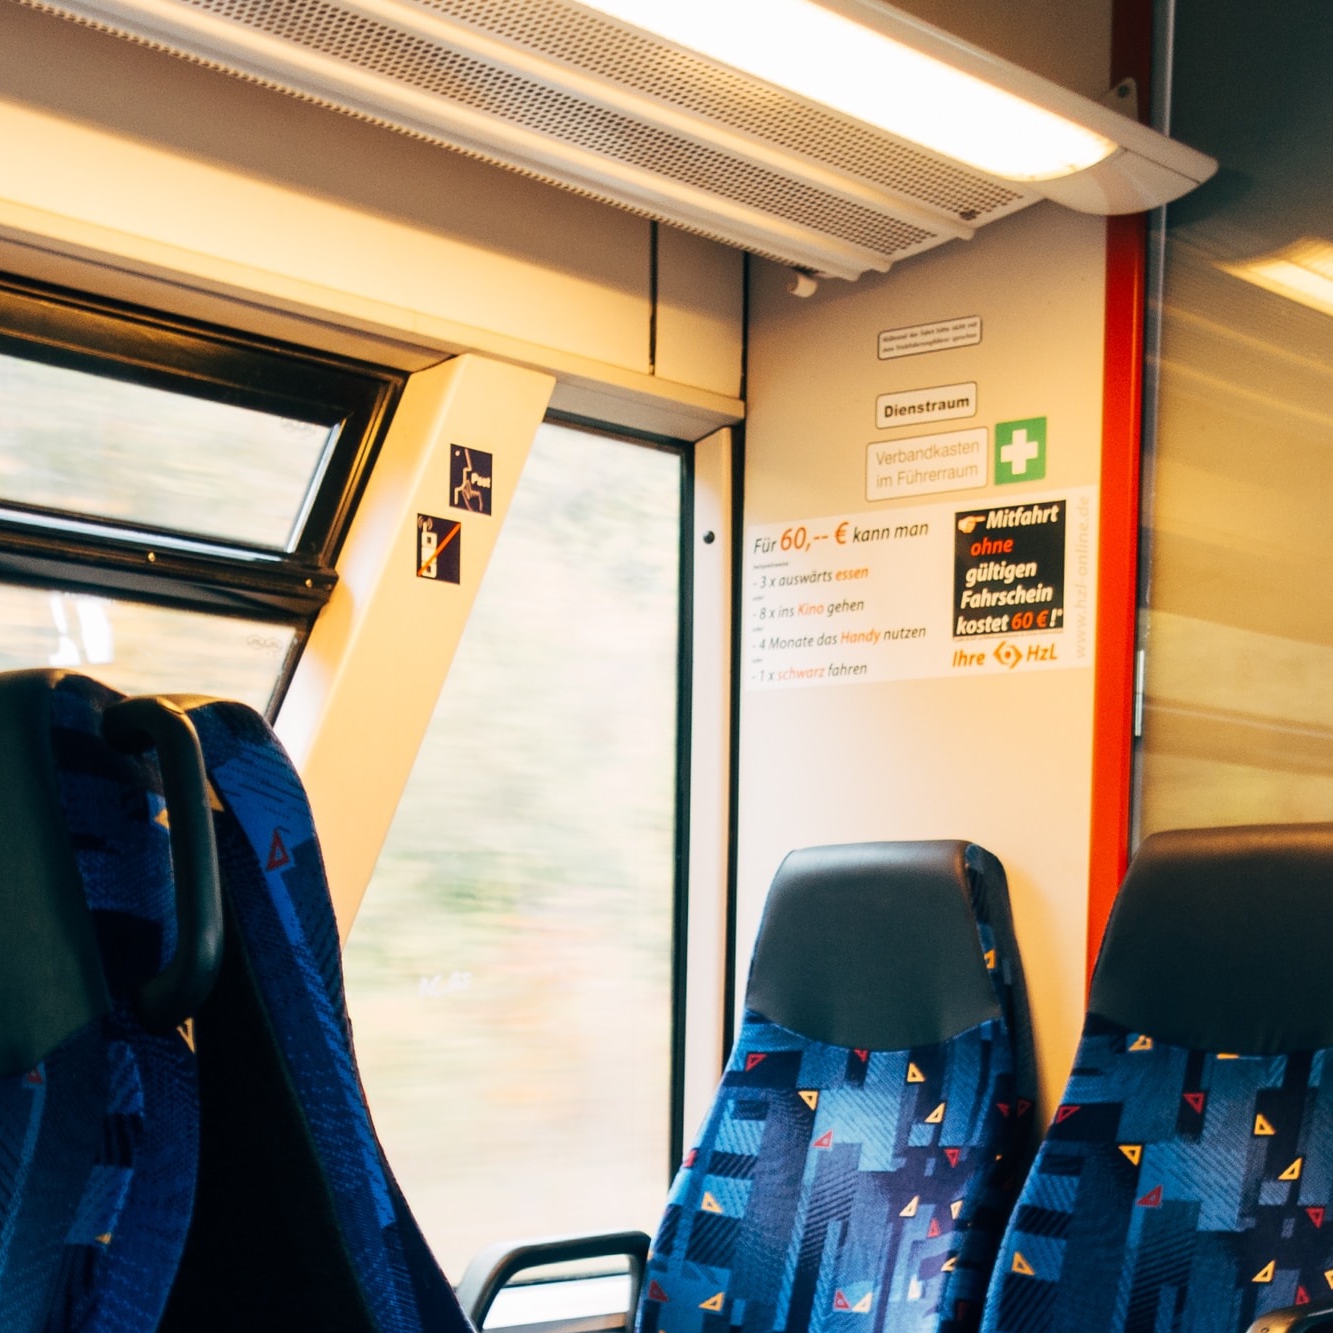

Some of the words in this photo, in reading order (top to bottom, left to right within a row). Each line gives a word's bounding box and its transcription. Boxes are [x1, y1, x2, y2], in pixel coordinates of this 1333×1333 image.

[883, 397, 970, 418] Dienstraum
[875, 441, 980, 466] Verbandkasten
[876, 474, 892, 489] im
[897, 464, 978, 486] Führerraum
[985, 504, 1059, 530] Mitfahrt
[753, 537, 777, 554] Für
[834, 521, 850, 545] €
[852, 526, 890, 543] kann
[894, 523, 929, 540] man
[970, 536, 1014, 556] ohne
[759, 575, 767, 589] 3
[769, 576, 777, 588] x
[778, 569, 833, 587] auswärts
[835, 567, 869, 581] essen
[965, 560, 1038, 588] gültigen
[1074, 495, 1090, 659] www.hzl-online.de
[960, 582, 1054, 610] Fahrschein
[758, 607, 767, 620] 8
[768, 608, 776, 620] x
[778, 604, 795, 619] ins
[797, 602, 825, 616] Kino
[826, 599, 865, 617] gehen
[956, 614, 1010, 635] kostet
[1011, 611, 1034, 630] 60
[758, 638, 767, 651] 4
[768, 636, 814, 650] Monate
[816, 632, 838, 647] das
[840, 628, 881, 646] Handy
[883, 626, 927, 641] nutzen
[952, 648, 986, 668] Ihre
[1026, 643, 1058, 662] HzL
[759, 669, 766, 682] 1
[767, 670, 775, 681] x
[776, 666, 826, 681] schwarz
[827, 662, 868, 677] fahren
